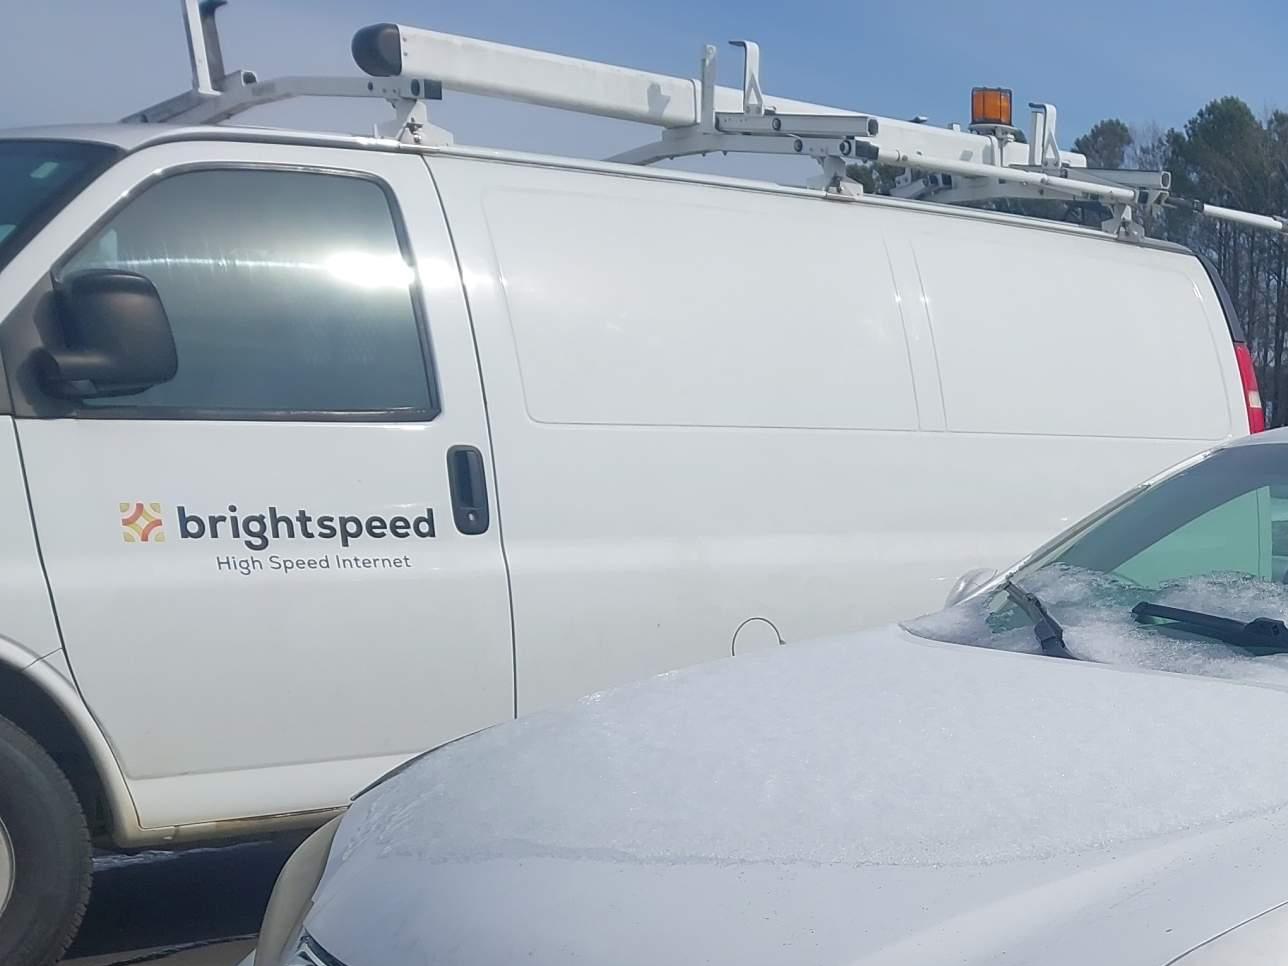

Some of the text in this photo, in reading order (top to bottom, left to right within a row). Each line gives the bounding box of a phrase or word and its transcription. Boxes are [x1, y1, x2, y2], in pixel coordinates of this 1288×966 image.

[177, 505, 436, 550] brightspeed
[216, 555, 411, 575] High Speed Internet
